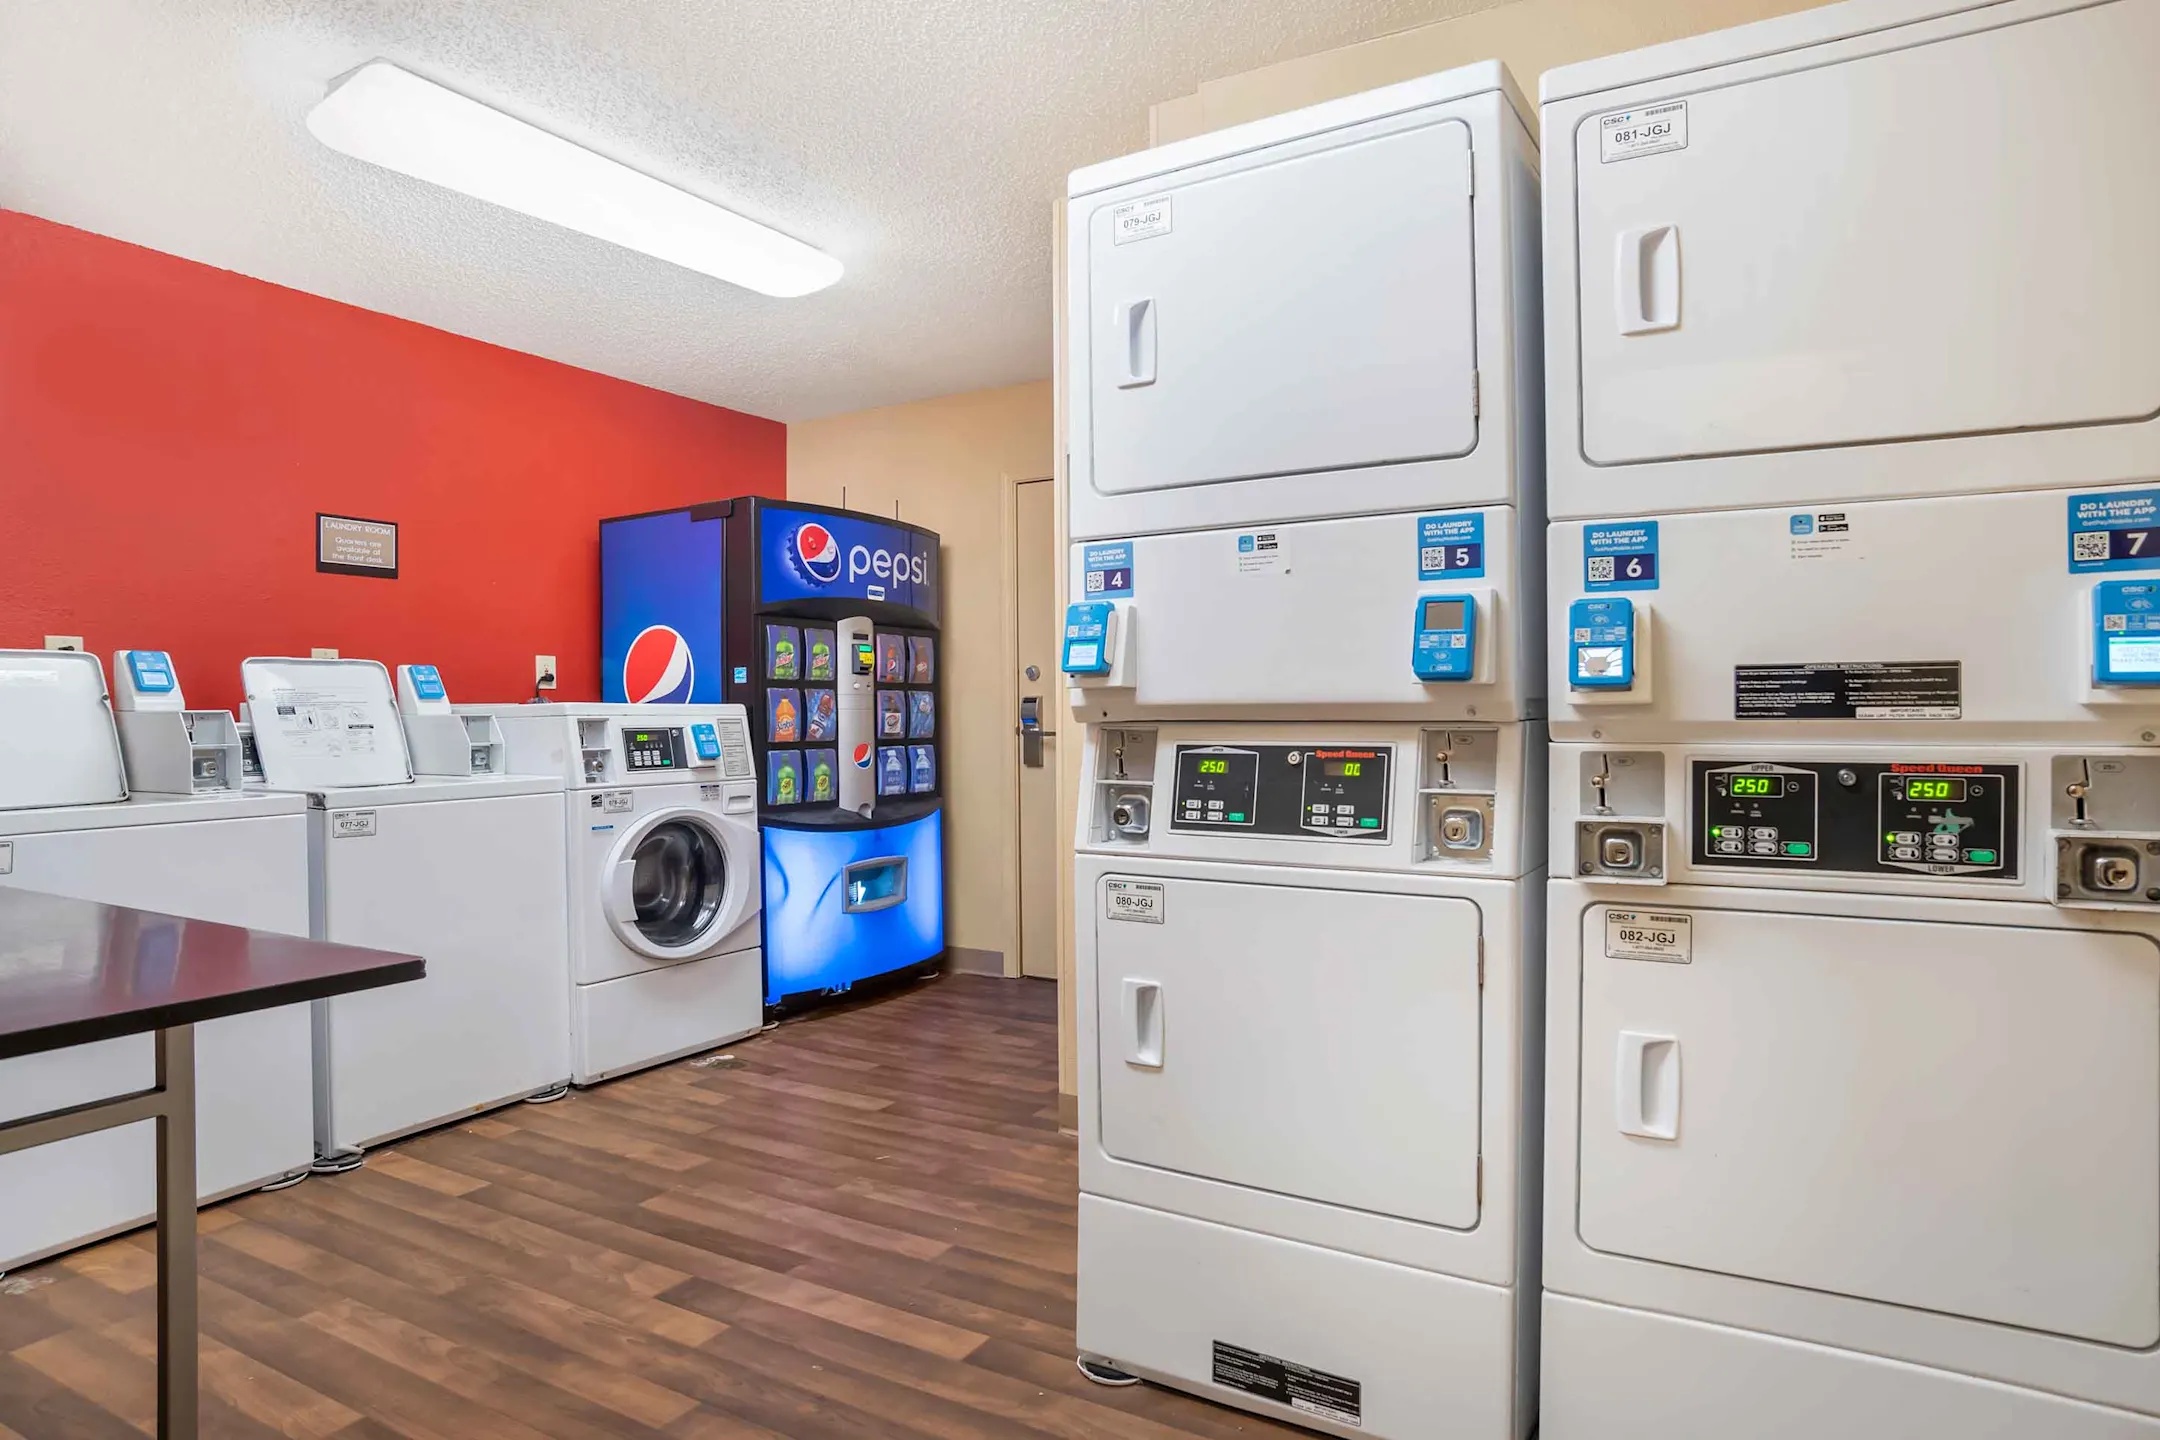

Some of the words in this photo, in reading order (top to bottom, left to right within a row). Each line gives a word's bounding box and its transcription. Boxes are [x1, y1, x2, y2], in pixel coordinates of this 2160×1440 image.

[1615, 122, 1671, 143] 081-JGJ
[1123, 211, 1161, 229] 079-JGJ
[2080, 503, 2096, 511] DO
[2099, 498, 2153, 509] LAUNDRY
[2076, 510, 2107, 518] WITH
[2108, 508, 2131, 516] THE
[2133, 506, 2157, 514] APP
[325, 520, 362, 532] LAUNDRY
[365, 525, 391, 536] ROOM
[1438, 520, 1472, 529] LAUNDRY
[1423, 529, 1444, 537] WITH
[1460, 526, 1476, 534] APP
[1606, 529, 1646, 538] LAUNDRY
[335, 536, 368, 547] Quarters
[1589, 538, 1612, 546] WITH
[1631, 535, 1649, 543] APP
[2126, 532, 2149, 555] 7
[336, 546, 371, 555] available
[1455, 547, 1470, 567] 5
[849, 545, 928, 589] pepsi
[1626, 557, 1642, 578] 6
[1111, 571, 1123, 588] 4
[1315, 750, 1345, 759] Speed
[1345, 750, 1376, 759] Queen
[1200, 760, 1225, 773] 250
[1751, 764, 1775, 772] UPPER
[1890, 763, 1935, 773] Speed
[1937, 763, 1983, 774] Queen
[1733, 778, 1770, 793] 250
[1909, 782, 1949, 797] 250
[340, 820, 369, 828] 077-JGJ
[1927, 864, 1955, 873] LOWER
[1115, 896, 1153, 908] 080-JGJ
[1619, 929, 1676, 944] 082-JGJ
